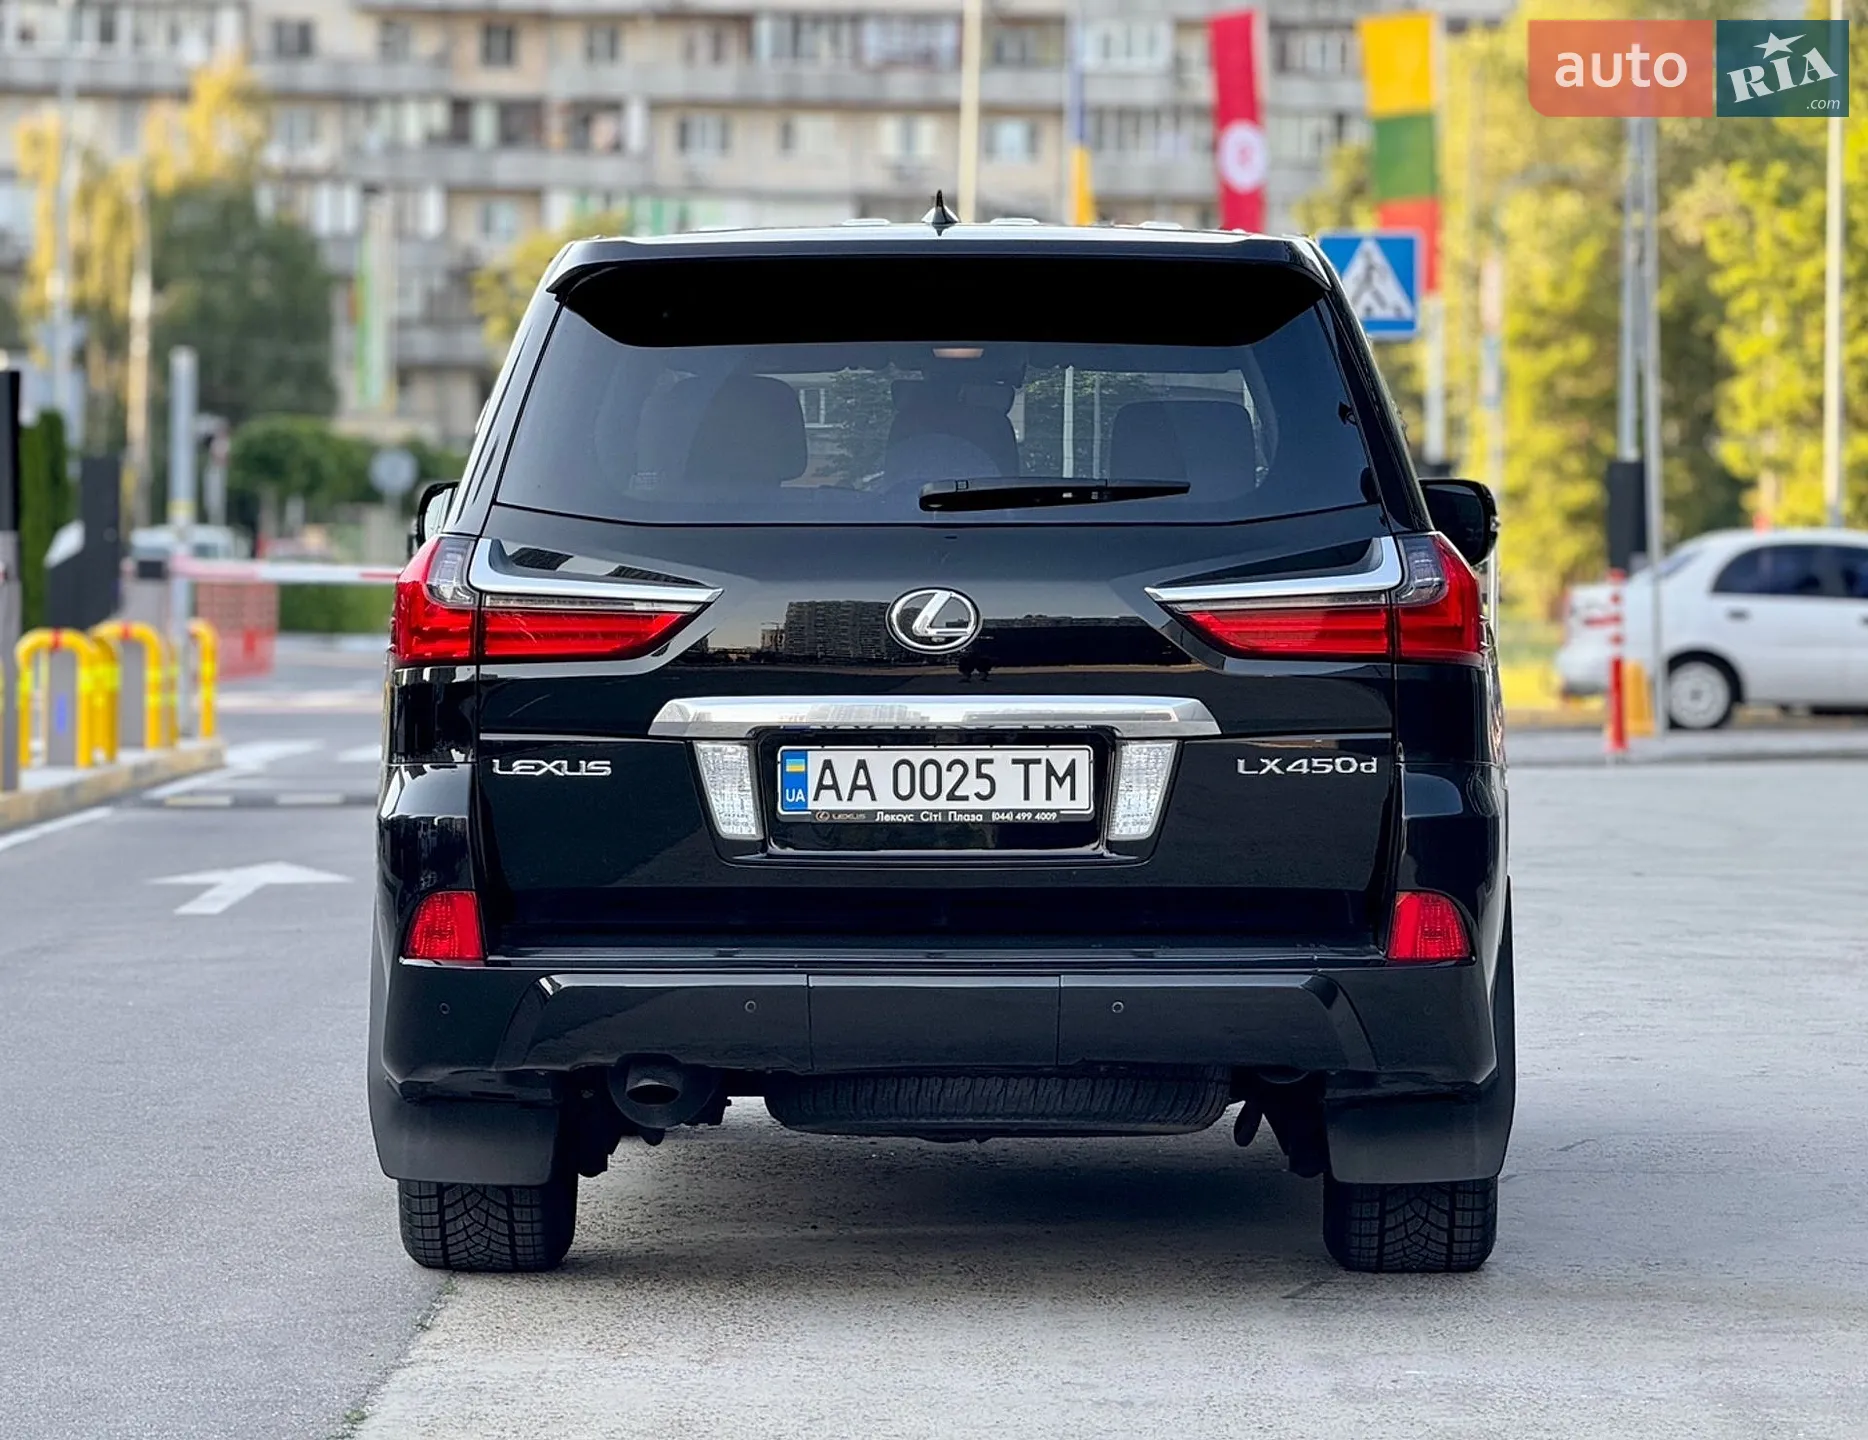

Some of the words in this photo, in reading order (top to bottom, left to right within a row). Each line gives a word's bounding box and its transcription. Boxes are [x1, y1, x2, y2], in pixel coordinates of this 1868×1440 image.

[492, 759, 612, 776] LEXUS
[1237, 757, 1378, 775] LX450d
[813, 758, 877, 801] AA
[892, 758, 996, 801] 0025
[1011, 758, 1077, 801] TM
[786, 788, 805, 803] UA
[875, 811, 915, 822] Лексус
[949, 811, 983, 822] Плаза
[991, 811, 1014, 822] (044)
[1015, 812, 1033, 821] 499
[1035, 812, 1057, 821] 4009
